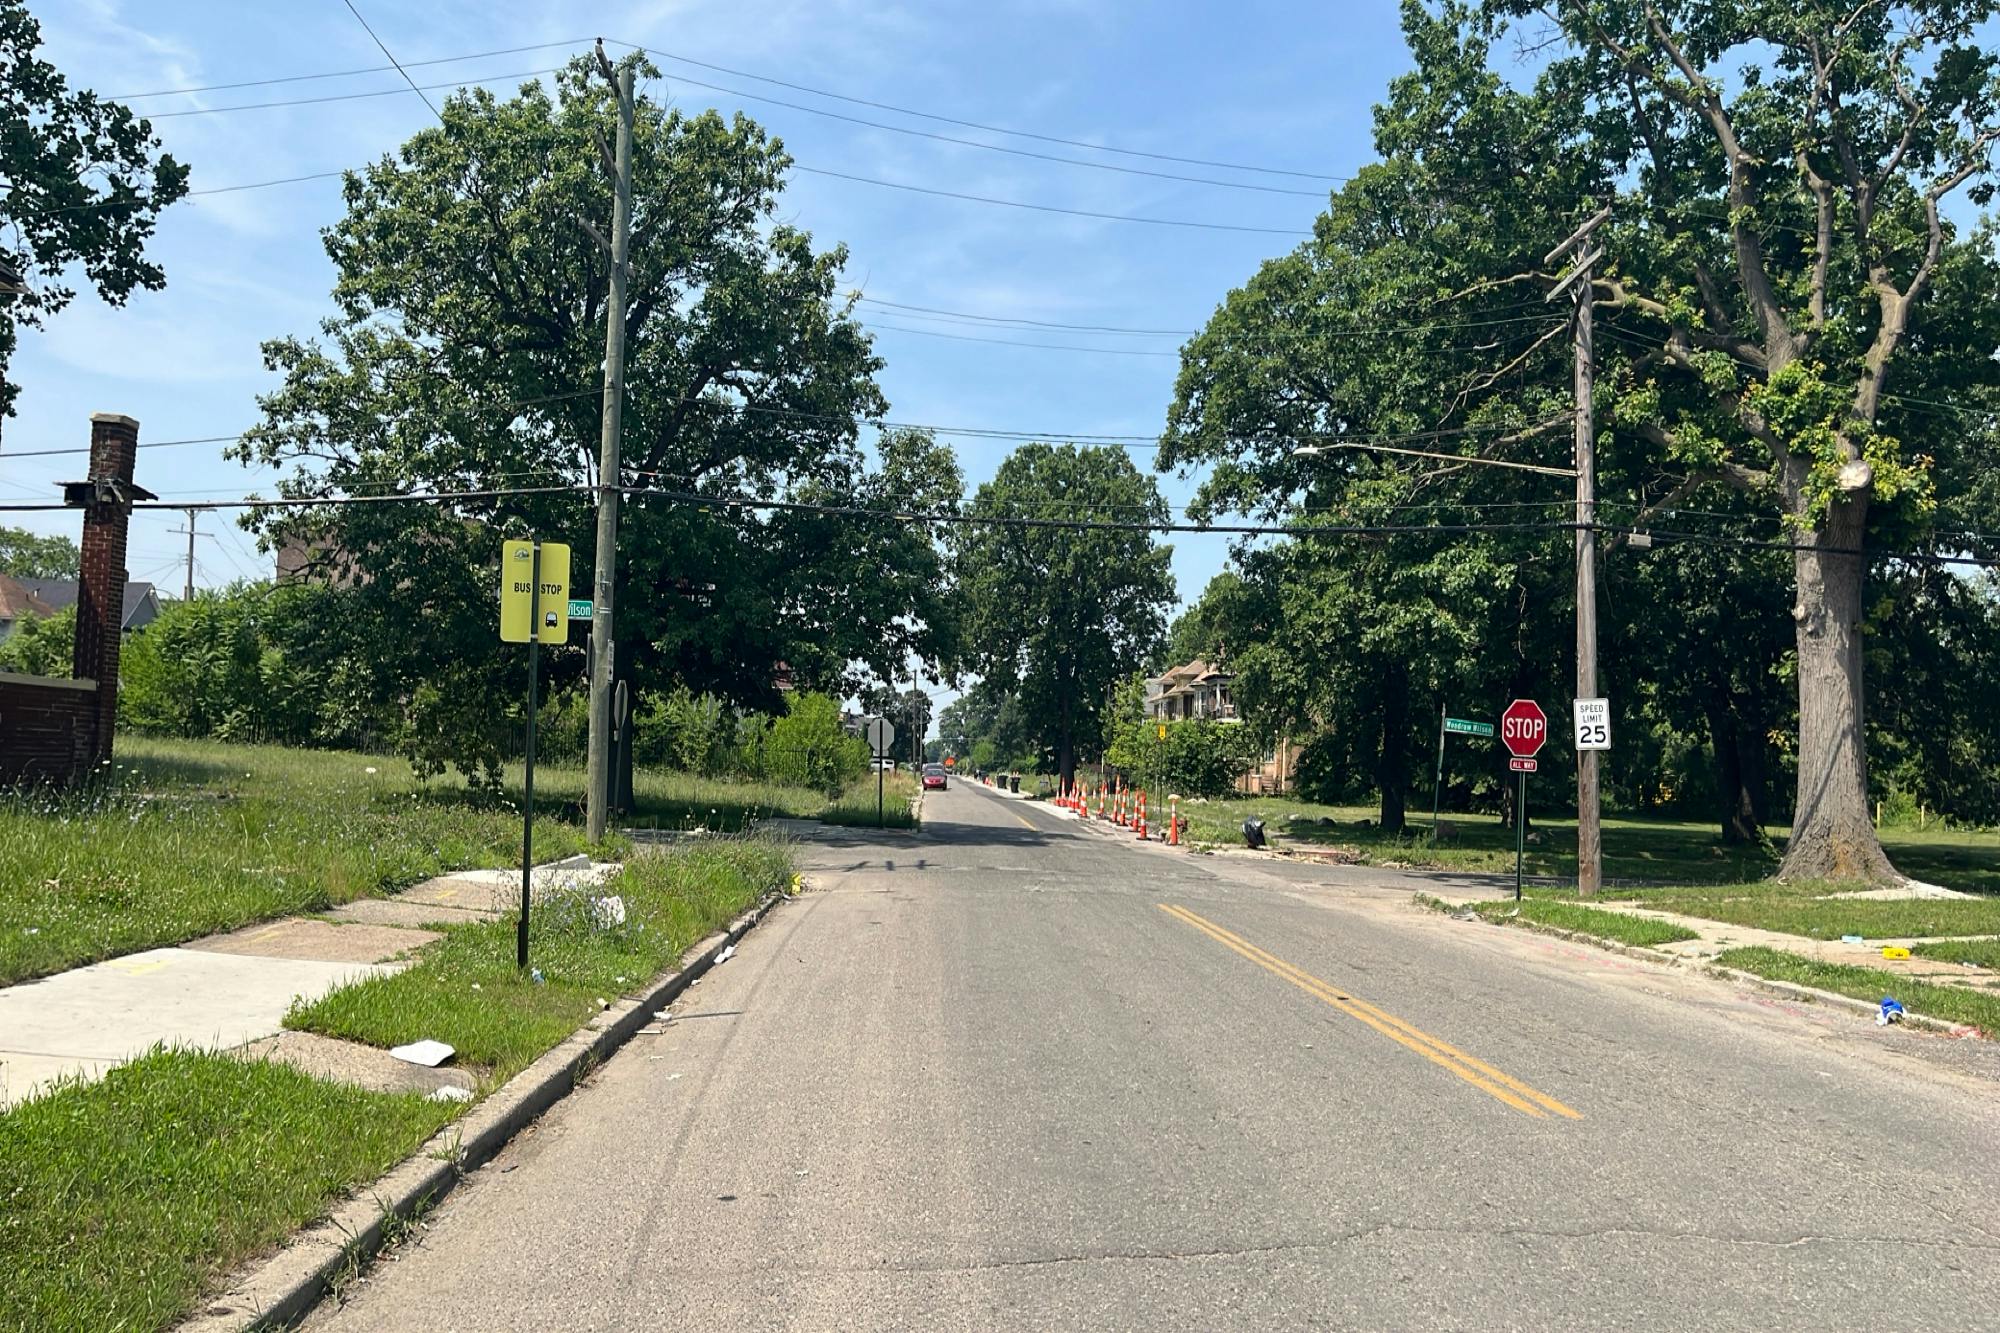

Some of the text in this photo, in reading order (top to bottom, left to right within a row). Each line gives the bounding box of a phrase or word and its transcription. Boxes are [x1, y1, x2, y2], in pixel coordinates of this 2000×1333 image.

[514, 582, 562, 595] BUS STOP
[1580, 704, 1604, 713] SPEED
[1583, 714, 1602, 723] LIMIT
[1472, 724, 1492, 734] Wilson
[1506, 718, 1543, 739] STOP
[1580, 725, 1606, 744] 25
[1512, 761, 1535, 770] ALL WAY
